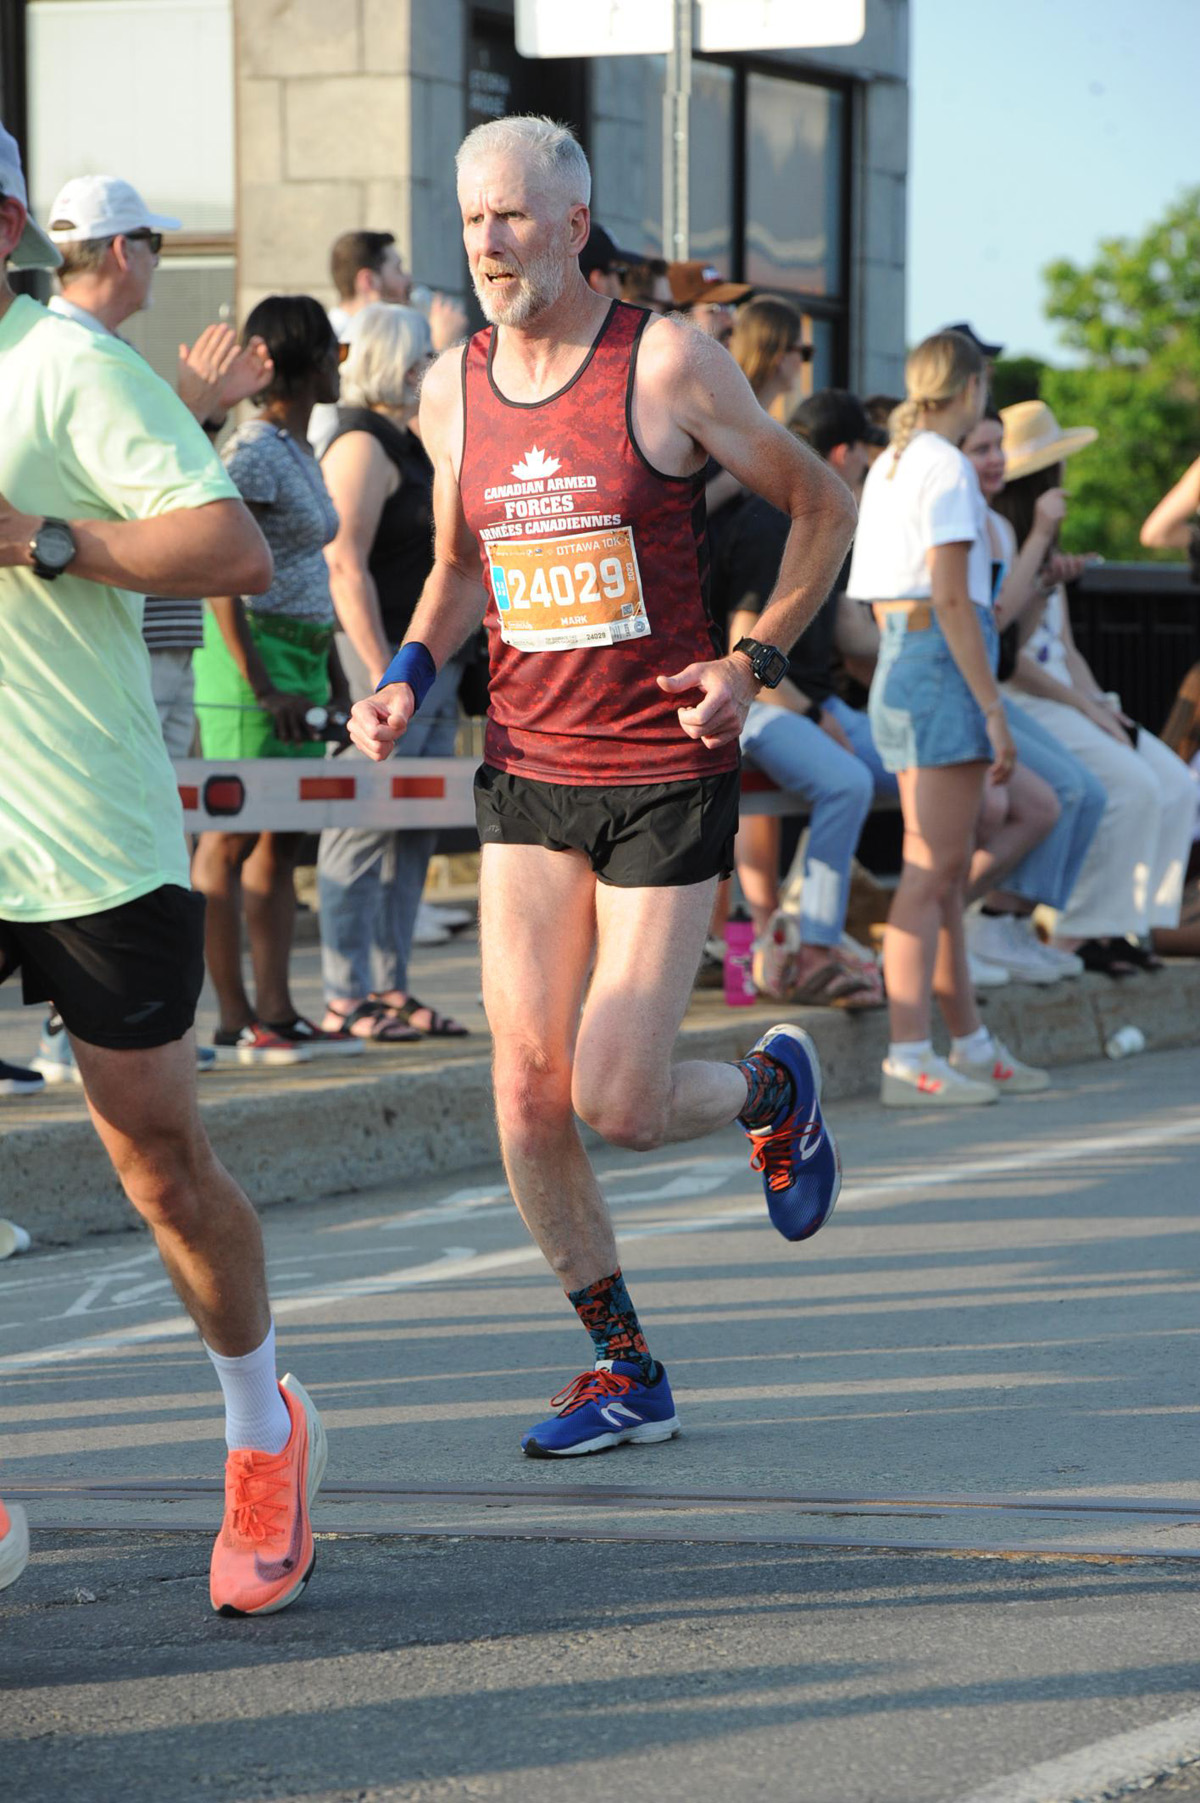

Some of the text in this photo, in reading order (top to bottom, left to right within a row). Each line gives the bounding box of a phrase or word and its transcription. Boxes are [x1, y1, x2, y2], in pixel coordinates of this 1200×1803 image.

[484, 475, 597, 500] CANADIAN ARMED
[504, 495, 574, 519] FORCES
[479, 514, 622, 541] ARMÉES CANADIENNES
[556, 537, 621, 556] OTTAWA 10K
[507, 557, 626, 609] 24029
[560, 615, 588, 626] MARK
